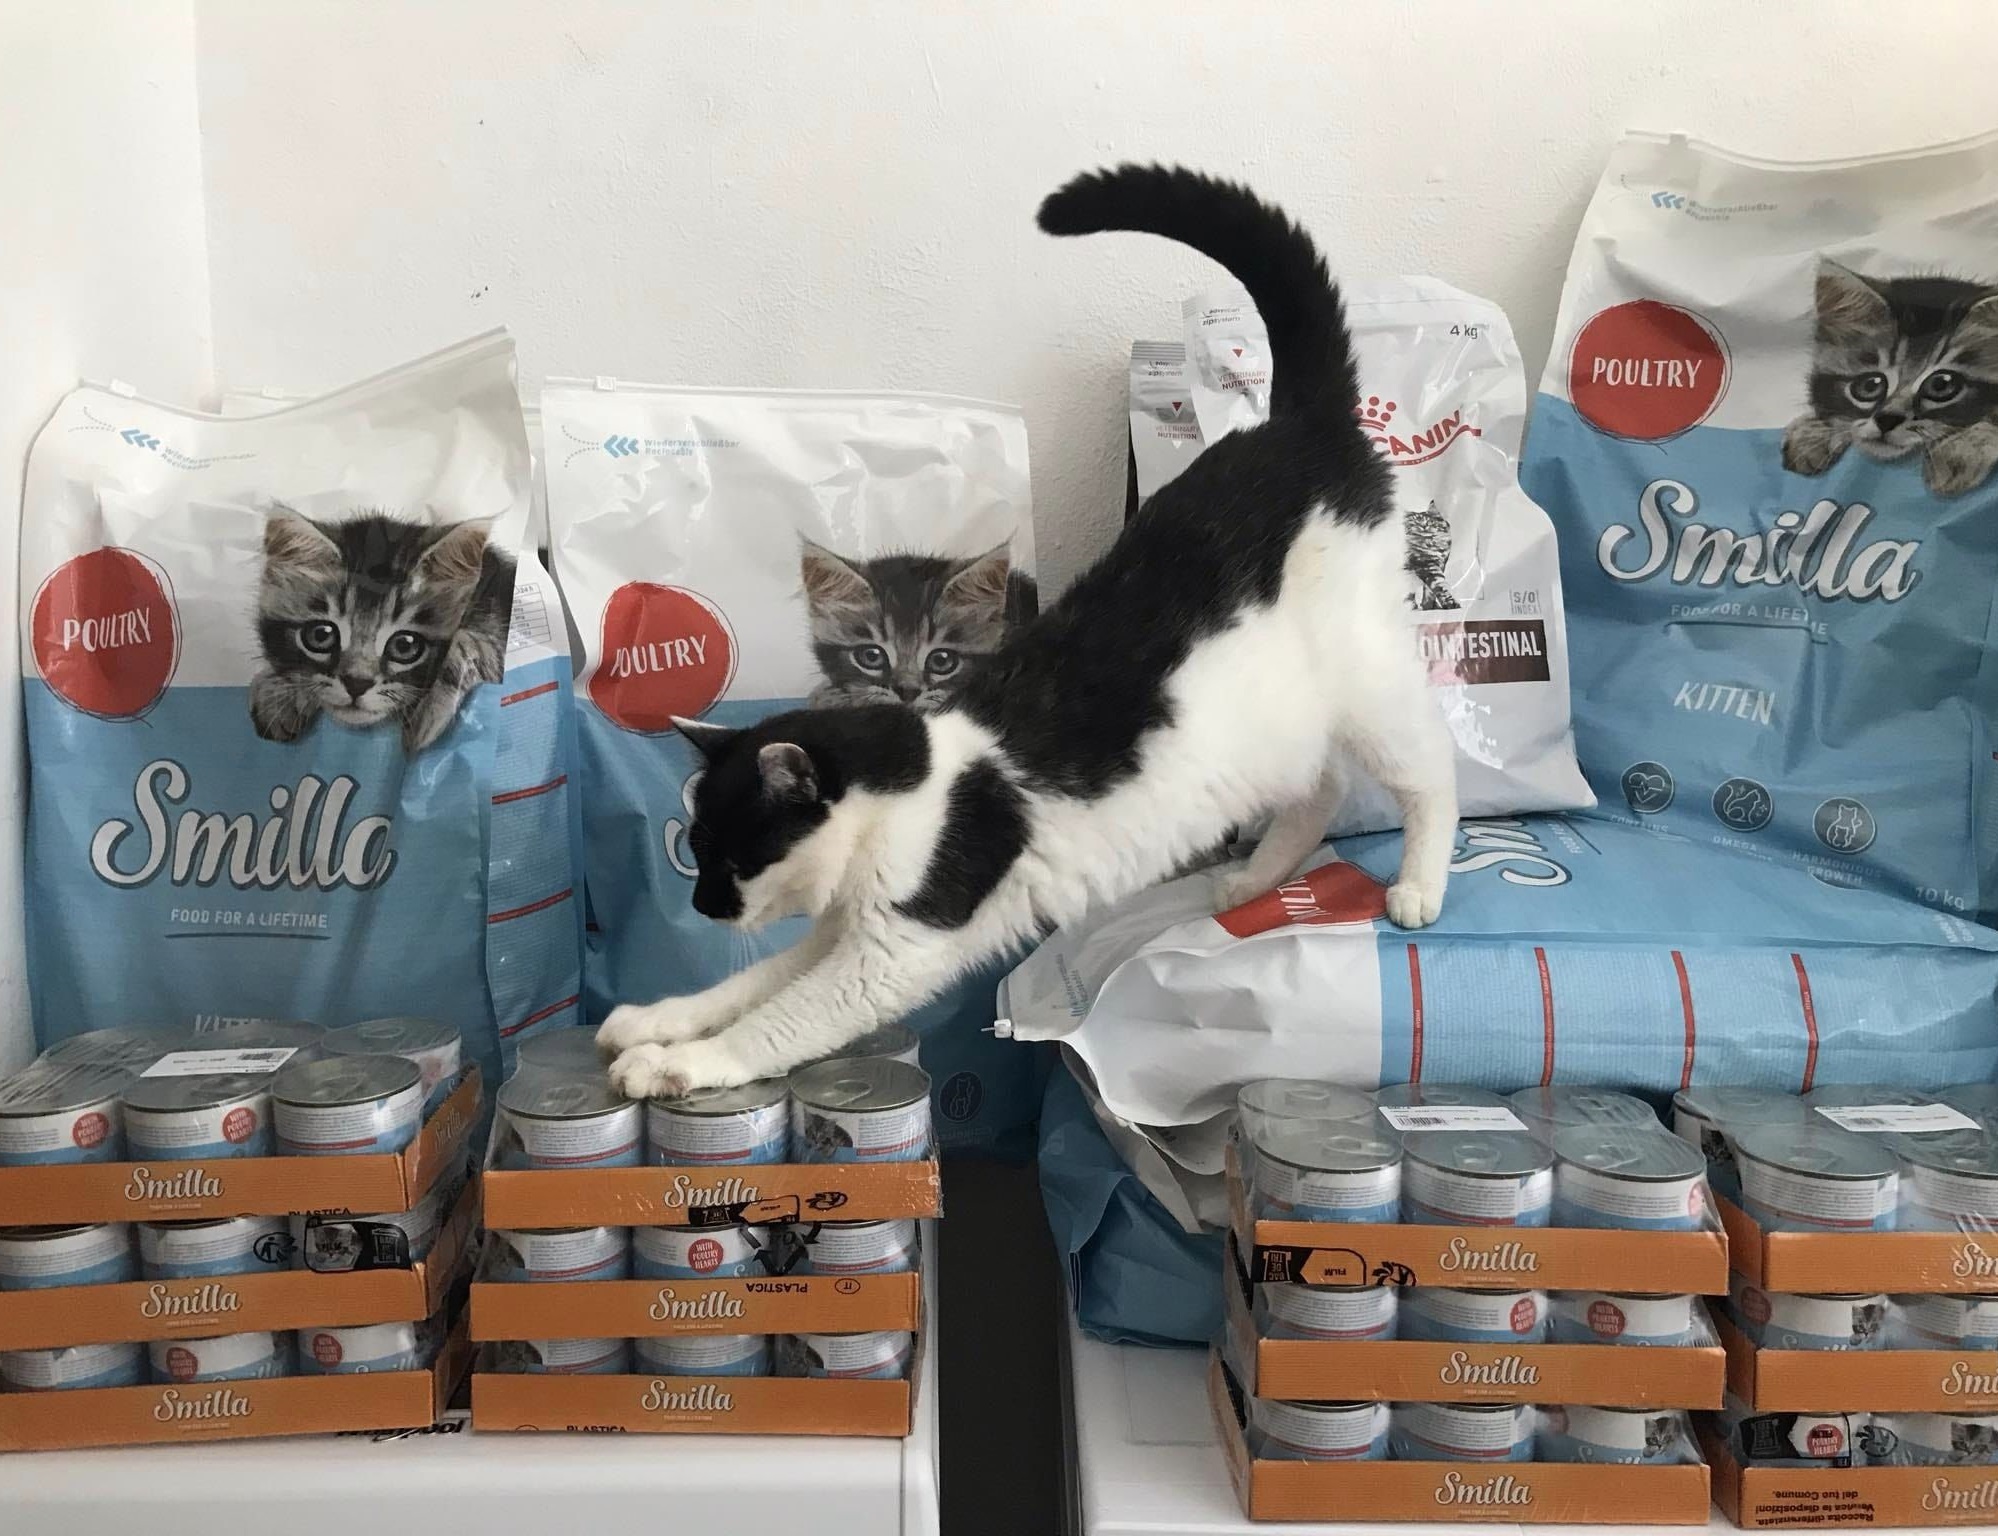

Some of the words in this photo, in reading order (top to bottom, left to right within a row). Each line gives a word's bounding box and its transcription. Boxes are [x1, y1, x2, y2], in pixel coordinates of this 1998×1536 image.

[1450, 325, 1460, 336] 4
[1464, 325, 1478, 339] kg
[1222, 378, 1265, 390] NUTRITION
[1593, 357, 1703, 389] POULTRY
[1158, 432, 1197, 440] NUTRITION
[1597, 479, 1923, 602] Smilla
[1748, 606, 1757, 617] A
[63, 607, 151, 653] POULTRY
[1673, 681, 1775, 727] KITTEN
[90, 759, 396, 891] Smilla
[1807, 865, 1863, 885] GROWTH
[1915, 886, 1938, 902] 10
[1944, 889, 1965, 911] kg
[171, 908, 209, 925] FOOD
[215, 909, 241, 925] FOR
[246, 912, 255, 926] A
[259, 911, 328, 929] LIFETIME
[124, 1166, 225, 1200] Smilla
[664, 1175, 763, 1209] Smilla
[692, 1250, 719, 1261] POULTRY
[696, 1241, 713, 1251] WITH
[1439, 1237, 1540, 1272] Smilla
[1324, 1268, 1346, 1276] FILM
[140, 1284, 243, 1318] Smilla
[746, 1283, 808, 1293] PLASTICA
[650, 1288, 745, 1320] Smilla
[1440, 1351, 1541, 1385] Smilla
[154, 1389, 253, 1421] Smilla
[641, 1380, 734, 1411] Smilla
[1435, 1471, 1533, 1505] Smilla
[1842, 1491, 1859, 1500] del
[1827, 1512, 1875, 1522] Raccolta
